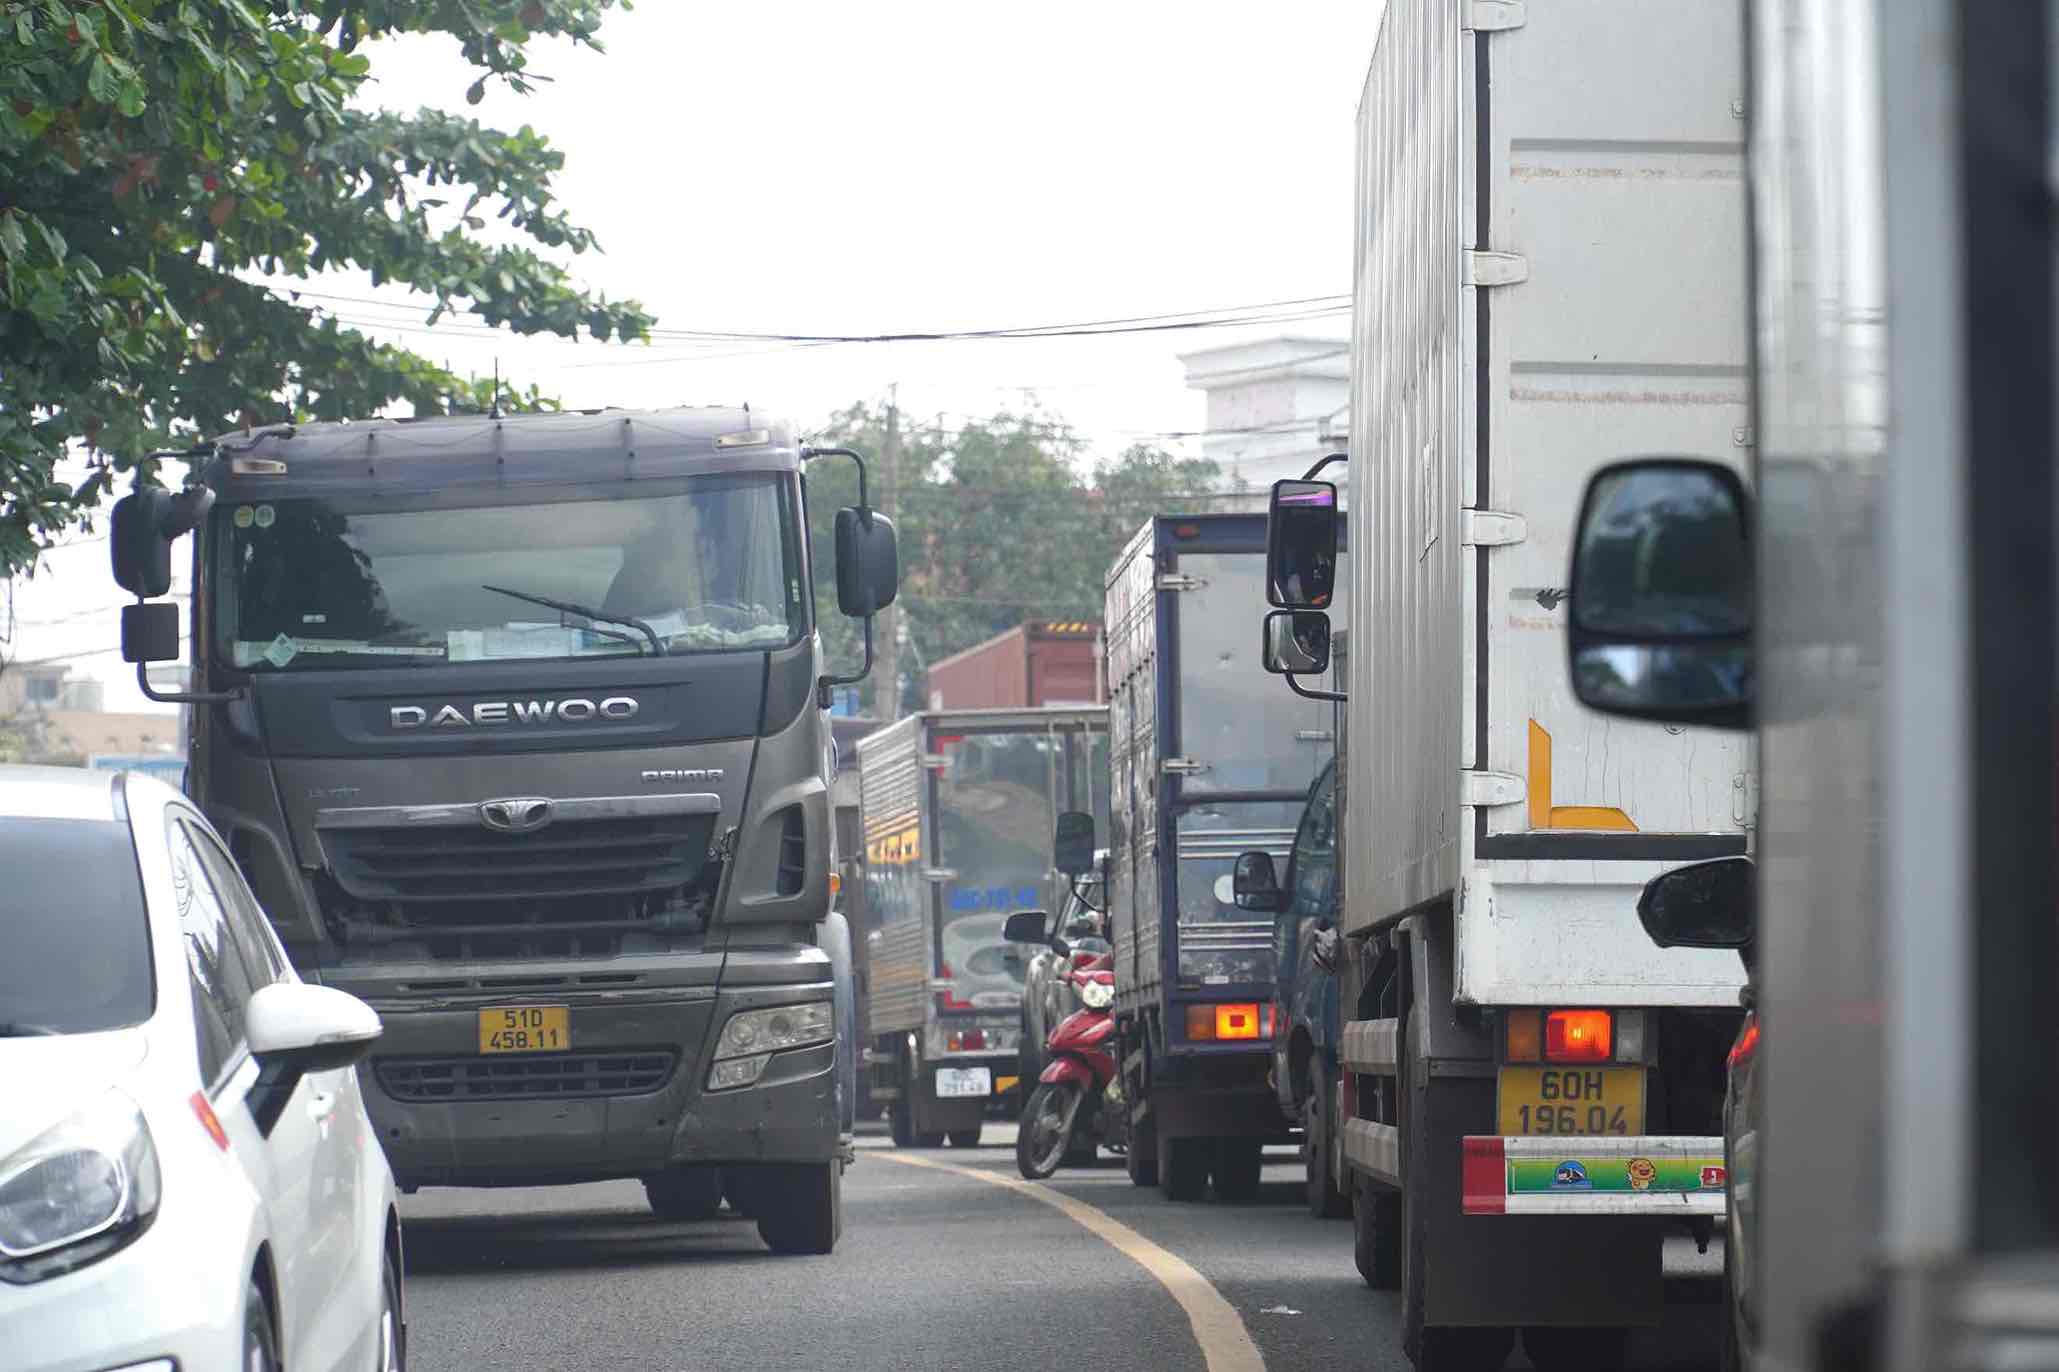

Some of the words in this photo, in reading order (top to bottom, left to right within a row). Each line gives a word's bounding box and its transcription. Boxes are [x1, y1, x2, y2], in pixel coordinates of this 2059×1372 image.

[391, 697, 640, 729] DAEWOO
[503, 1008, 543, 1028] 51D
[489, 1028, 558, 1050] 458.11
[1541, 1071, 1604, 1100] 60H
[1518, 1104, 1627, 1135] 196.04
